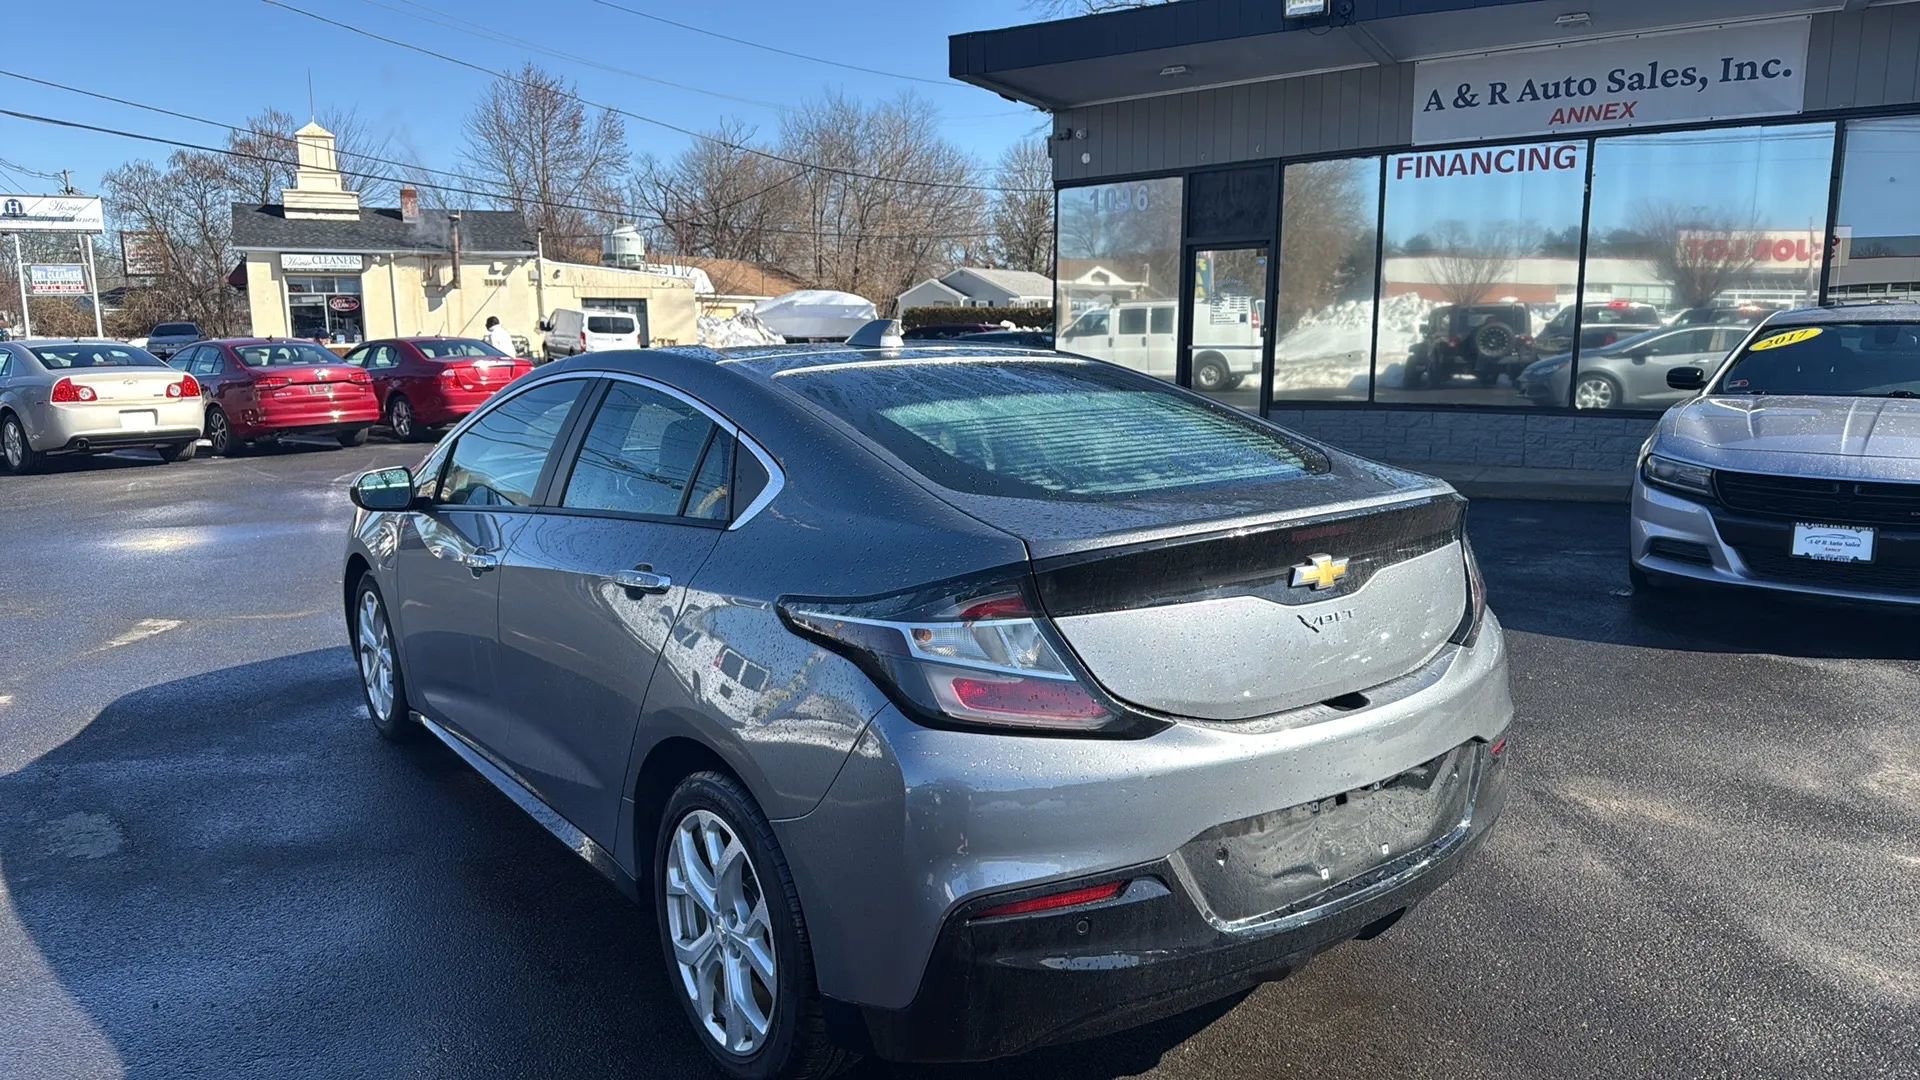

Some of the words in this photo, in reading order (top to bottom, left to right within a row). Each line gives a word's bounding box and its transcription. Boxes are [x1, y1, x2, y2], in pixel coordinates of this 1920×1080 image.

[1423, 88, 1446, 112] A
[1452, 83, 1480, 108] &
[1488, 82, 1511, 105] R
[1516, 73, 1598, 103] Auto
[1606, 60, 1709, 94] Sales,
[1719, 54, 1794, 84] Inc.
[1548, 100, 1639, 126] ANNEX
[1396, 144, 1577, 180] FINANCING
[1089, 183, 1150, 216] 1096
[311, 255, 361, 266] CLEANERS
[1765, 329, 1809, 349] 2017
[1296, 608, 1357, 634] VOLT
